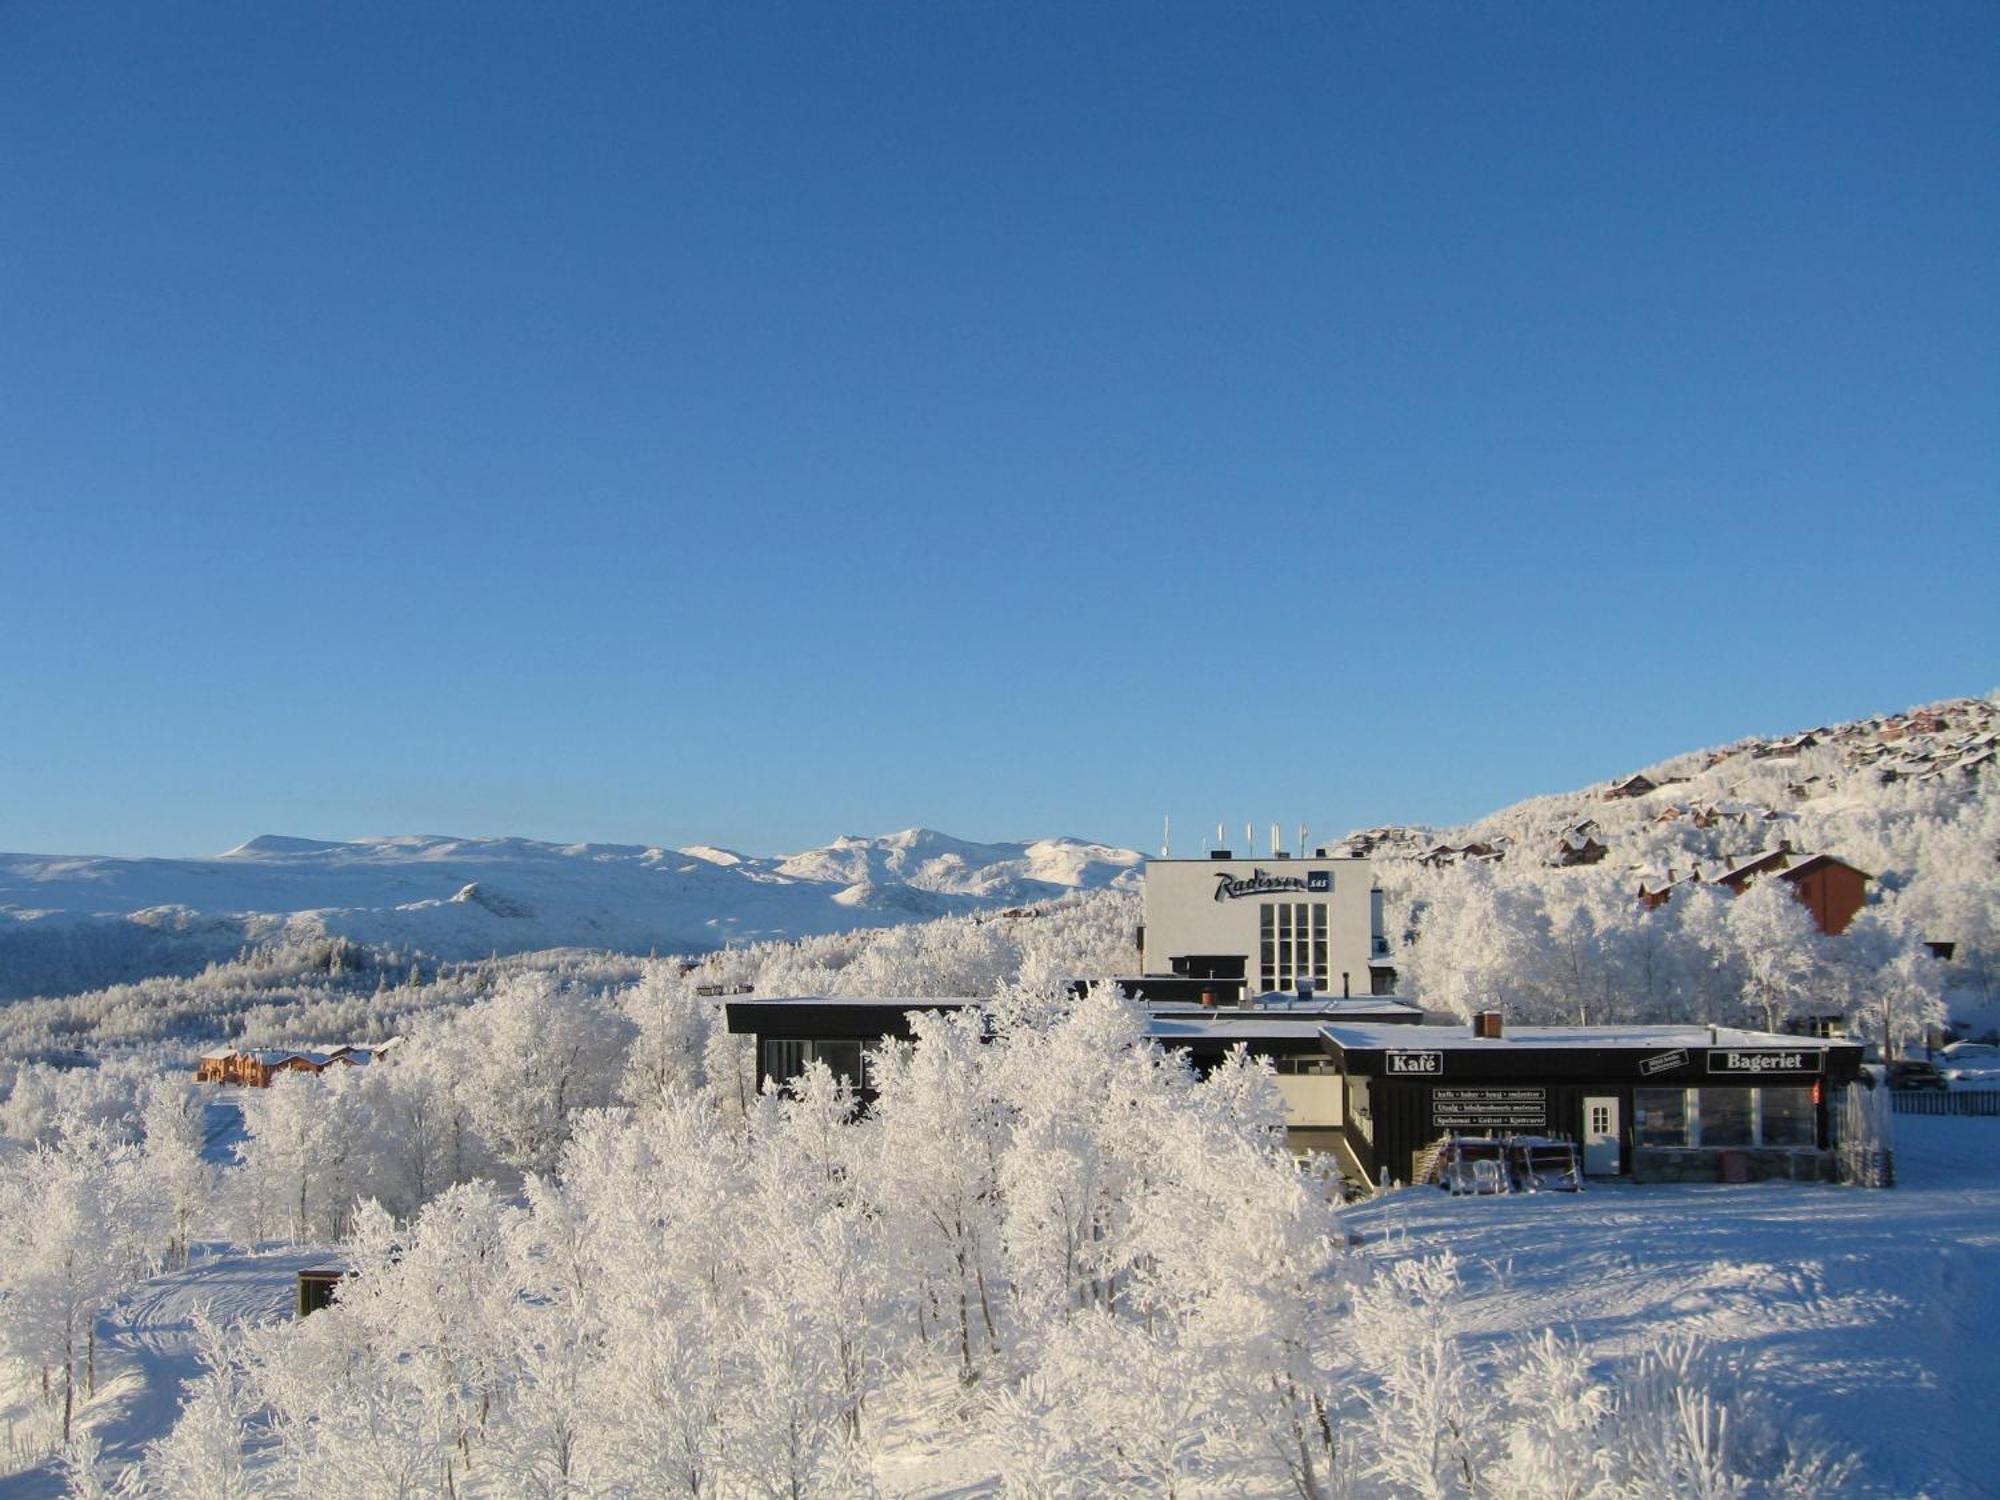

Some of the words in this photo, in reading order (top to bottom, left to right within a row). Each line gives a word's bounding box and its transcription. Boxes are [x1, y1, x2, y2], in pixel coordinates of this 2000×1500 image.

[1214, 868, 1307, 901] Radisson
[1310, 879, 1327, 888] SAS
[1393, 1055, 1435, 1072] Kafé
[1727, 1052, 1802, 1072] Bageriet
